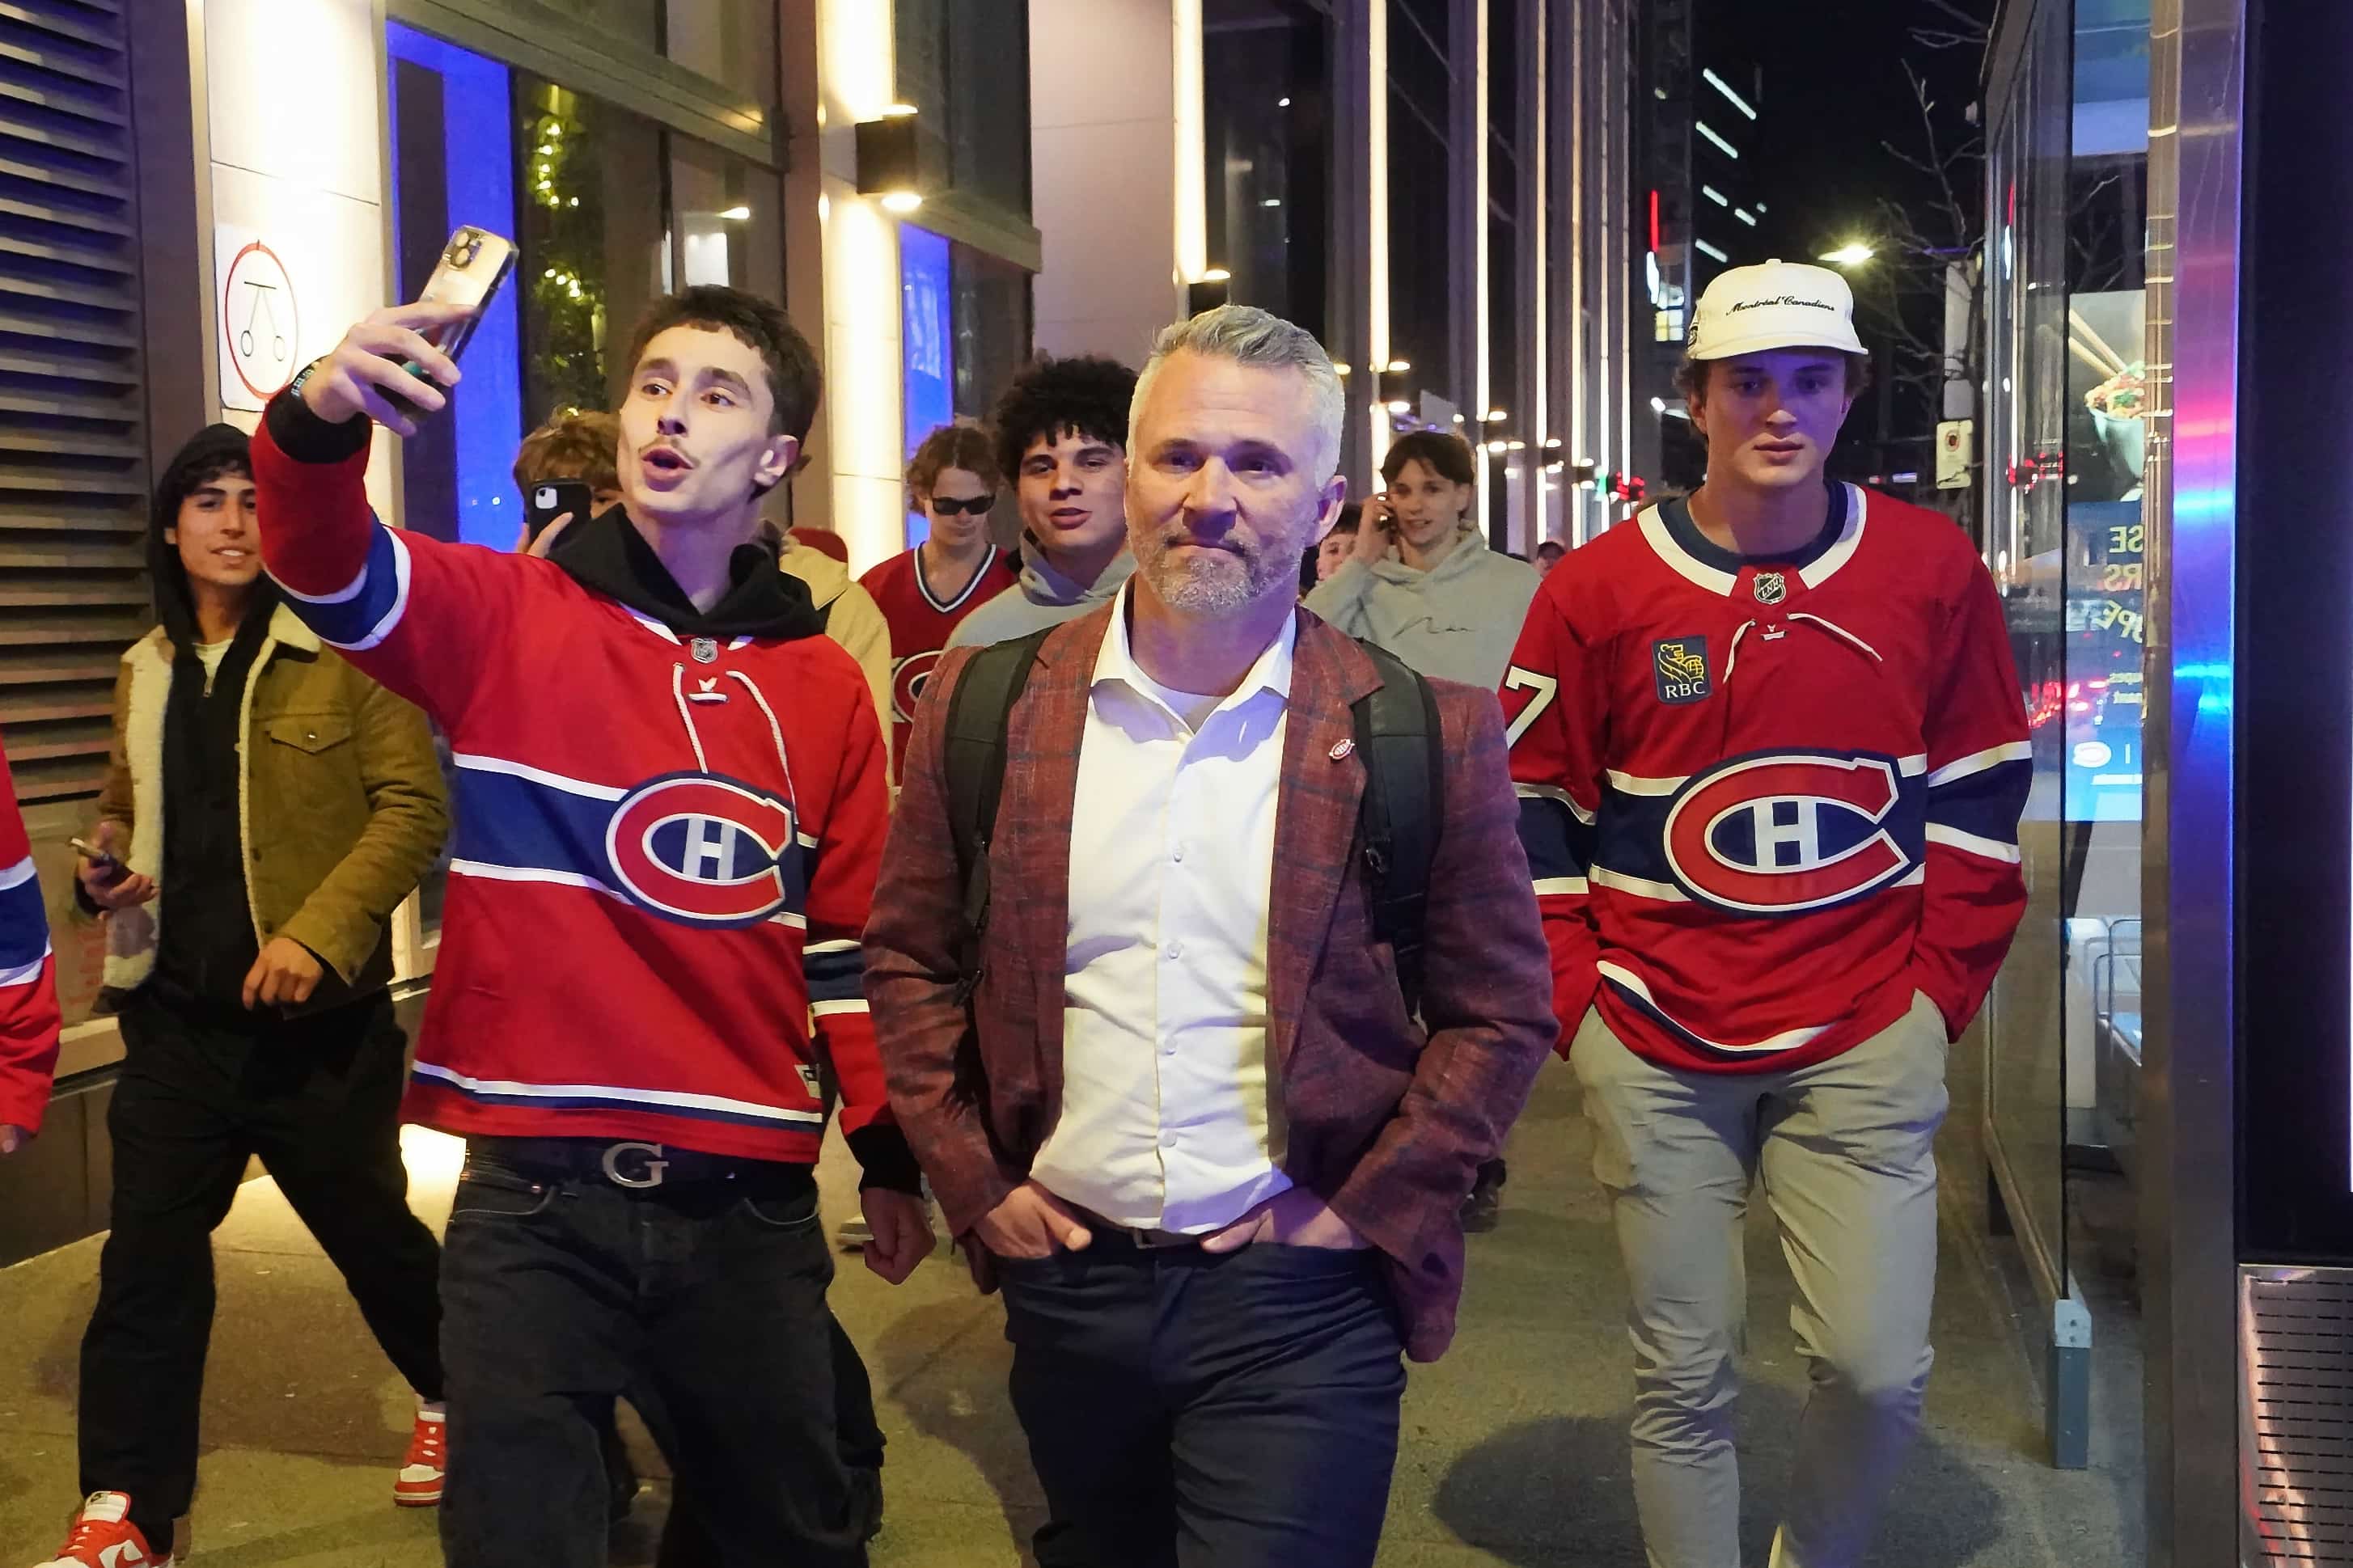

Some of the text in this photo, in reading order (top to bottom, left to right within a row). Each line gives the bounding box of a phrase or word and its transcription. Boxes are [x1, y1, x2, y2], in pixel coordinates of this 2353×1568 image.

[1725, 296, 1835, 315] Montréal Canadiens
[1665, 681, 1706, 699] RBC
[602, 1142, 670, 1188] G
